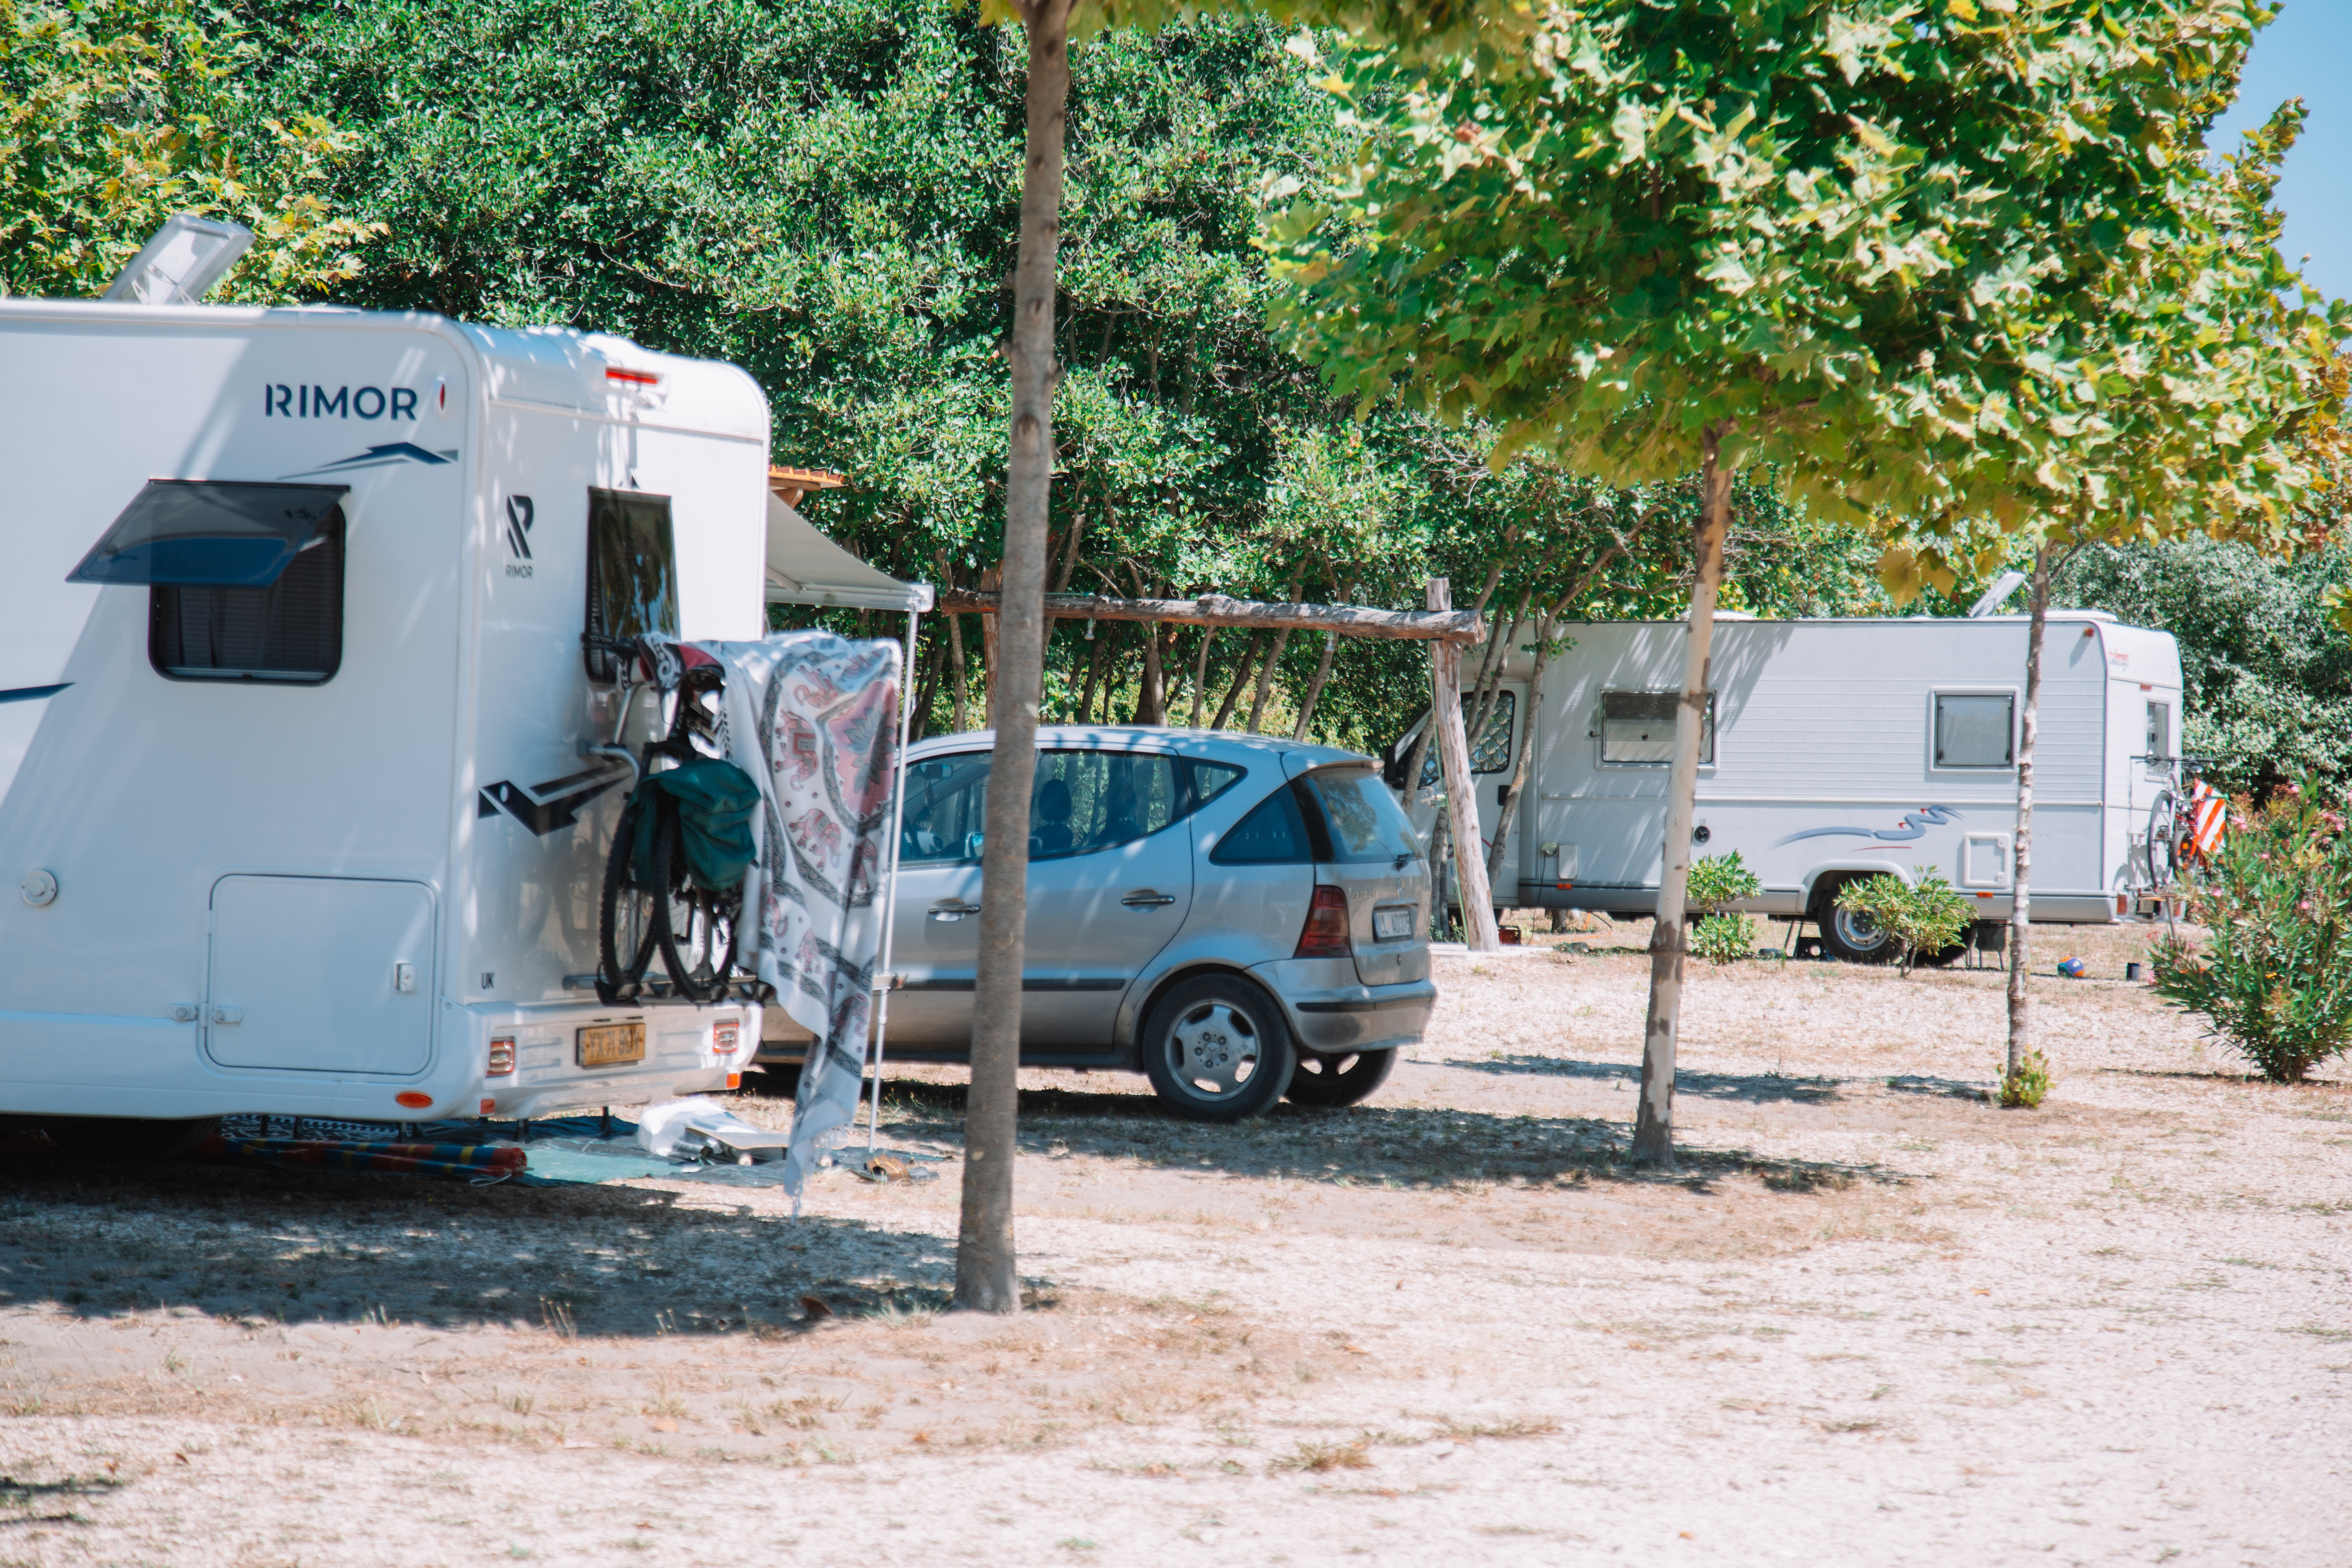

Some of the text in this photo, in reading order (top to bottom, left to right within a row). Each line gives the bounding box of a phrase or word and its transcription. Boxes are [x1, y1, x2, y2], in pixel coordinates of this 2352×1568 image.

[265, 384, 417, 421] RIMOR
[505, 565, 532, 579] RIMOR
[1377, 915, 1389, 935] UL
[481, 972, 494, 990] UK
